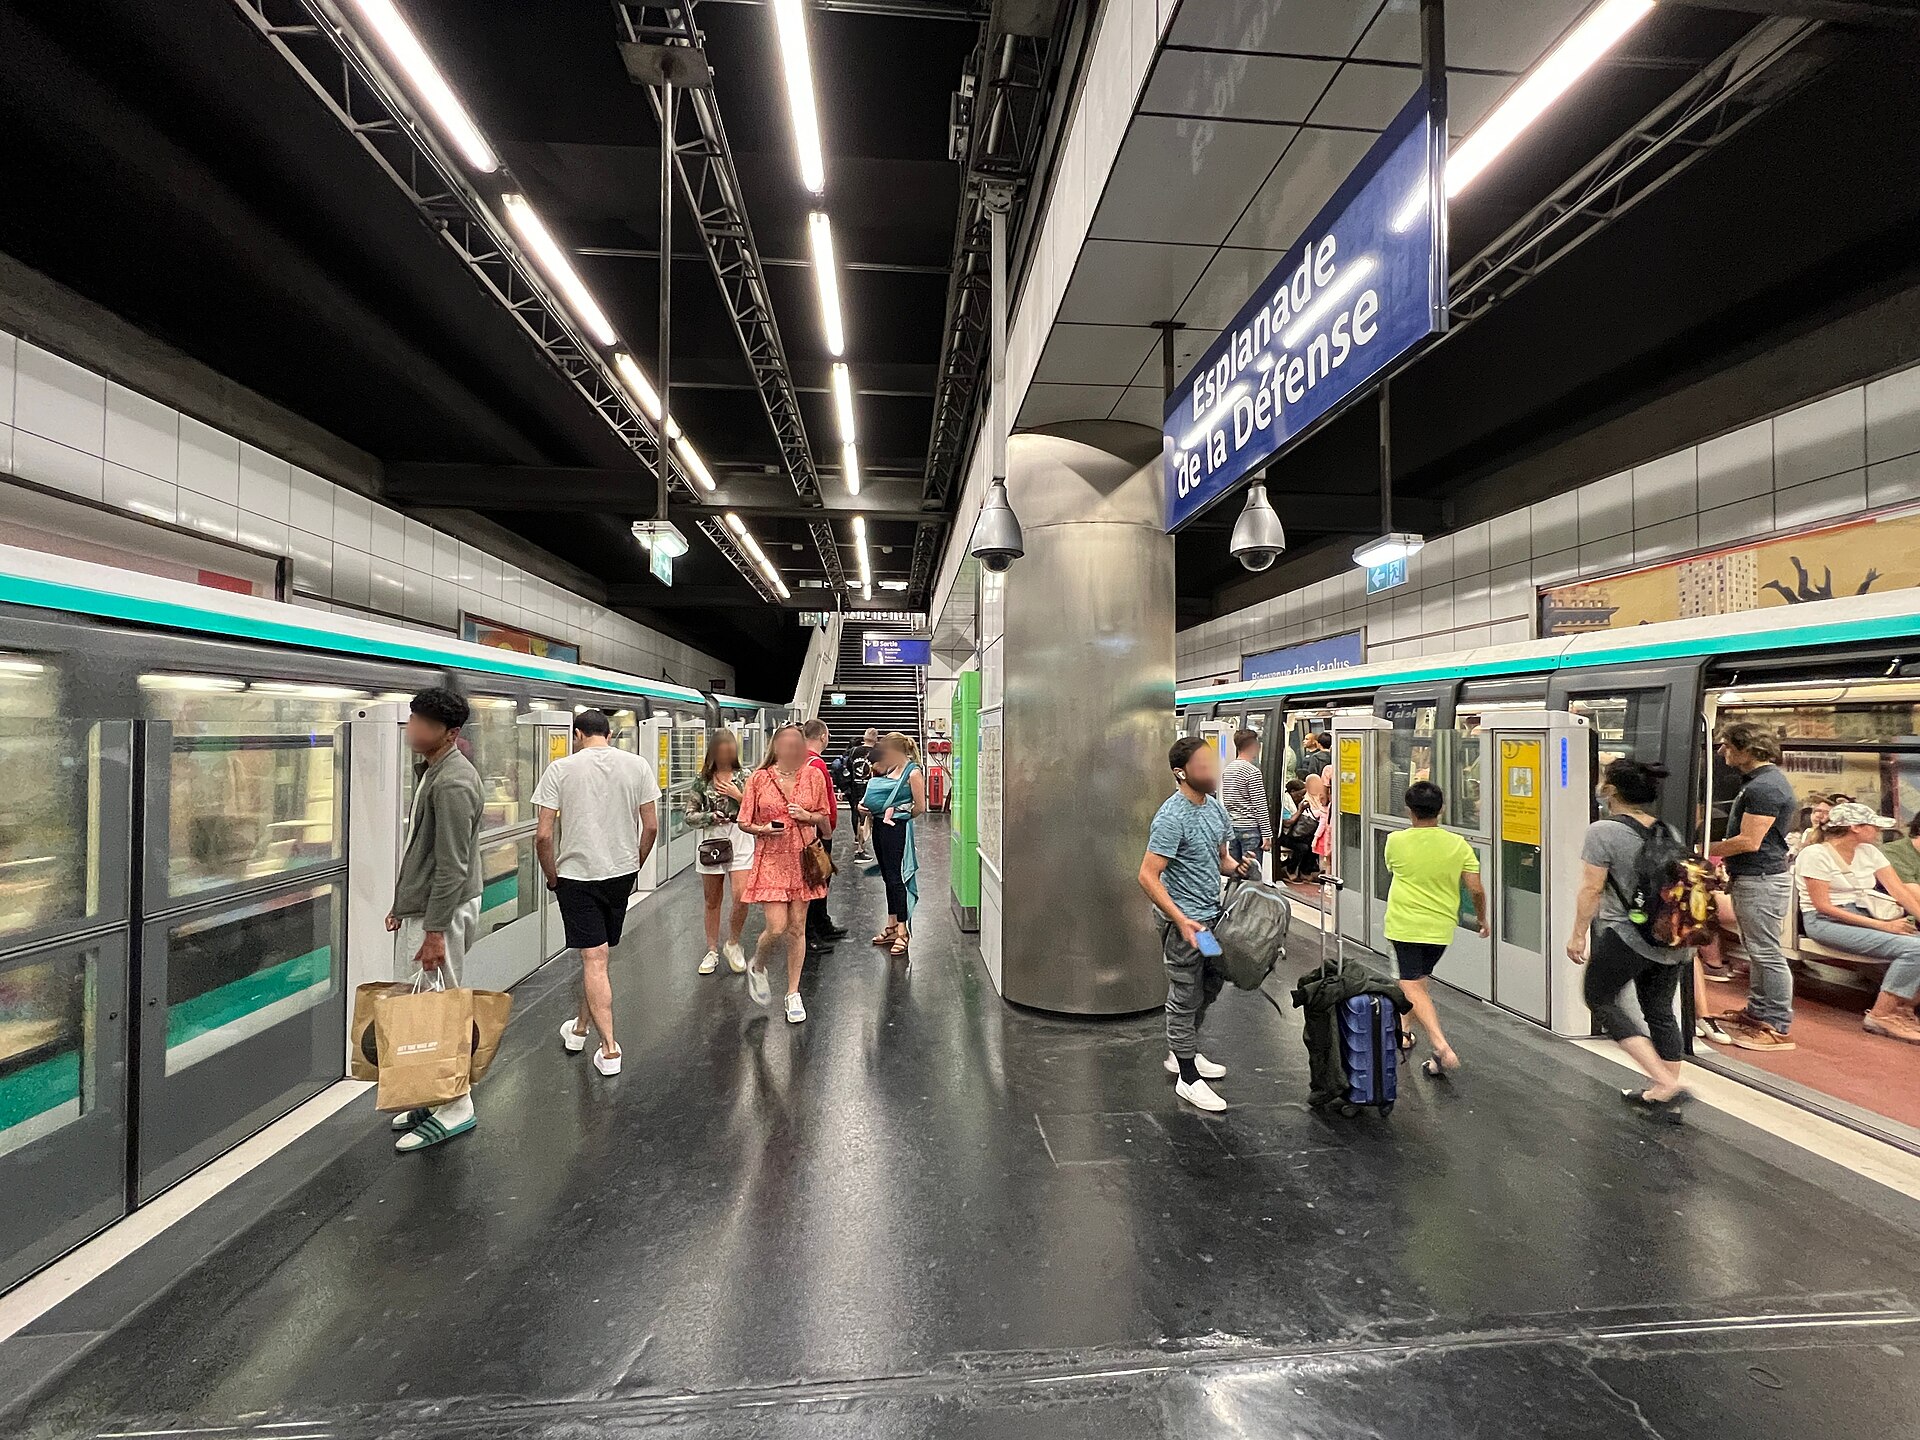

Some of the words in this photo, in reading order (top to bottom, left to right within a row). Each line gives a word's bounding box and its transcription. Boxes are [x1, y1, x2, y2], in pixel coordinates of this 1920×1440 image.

[1176, 452, 1202, 499] de
[1206, 428, 1227, 476] la
[1233, 289, 1379, 452] Défense
[1193, 234, 1337, 422] Esplanade
